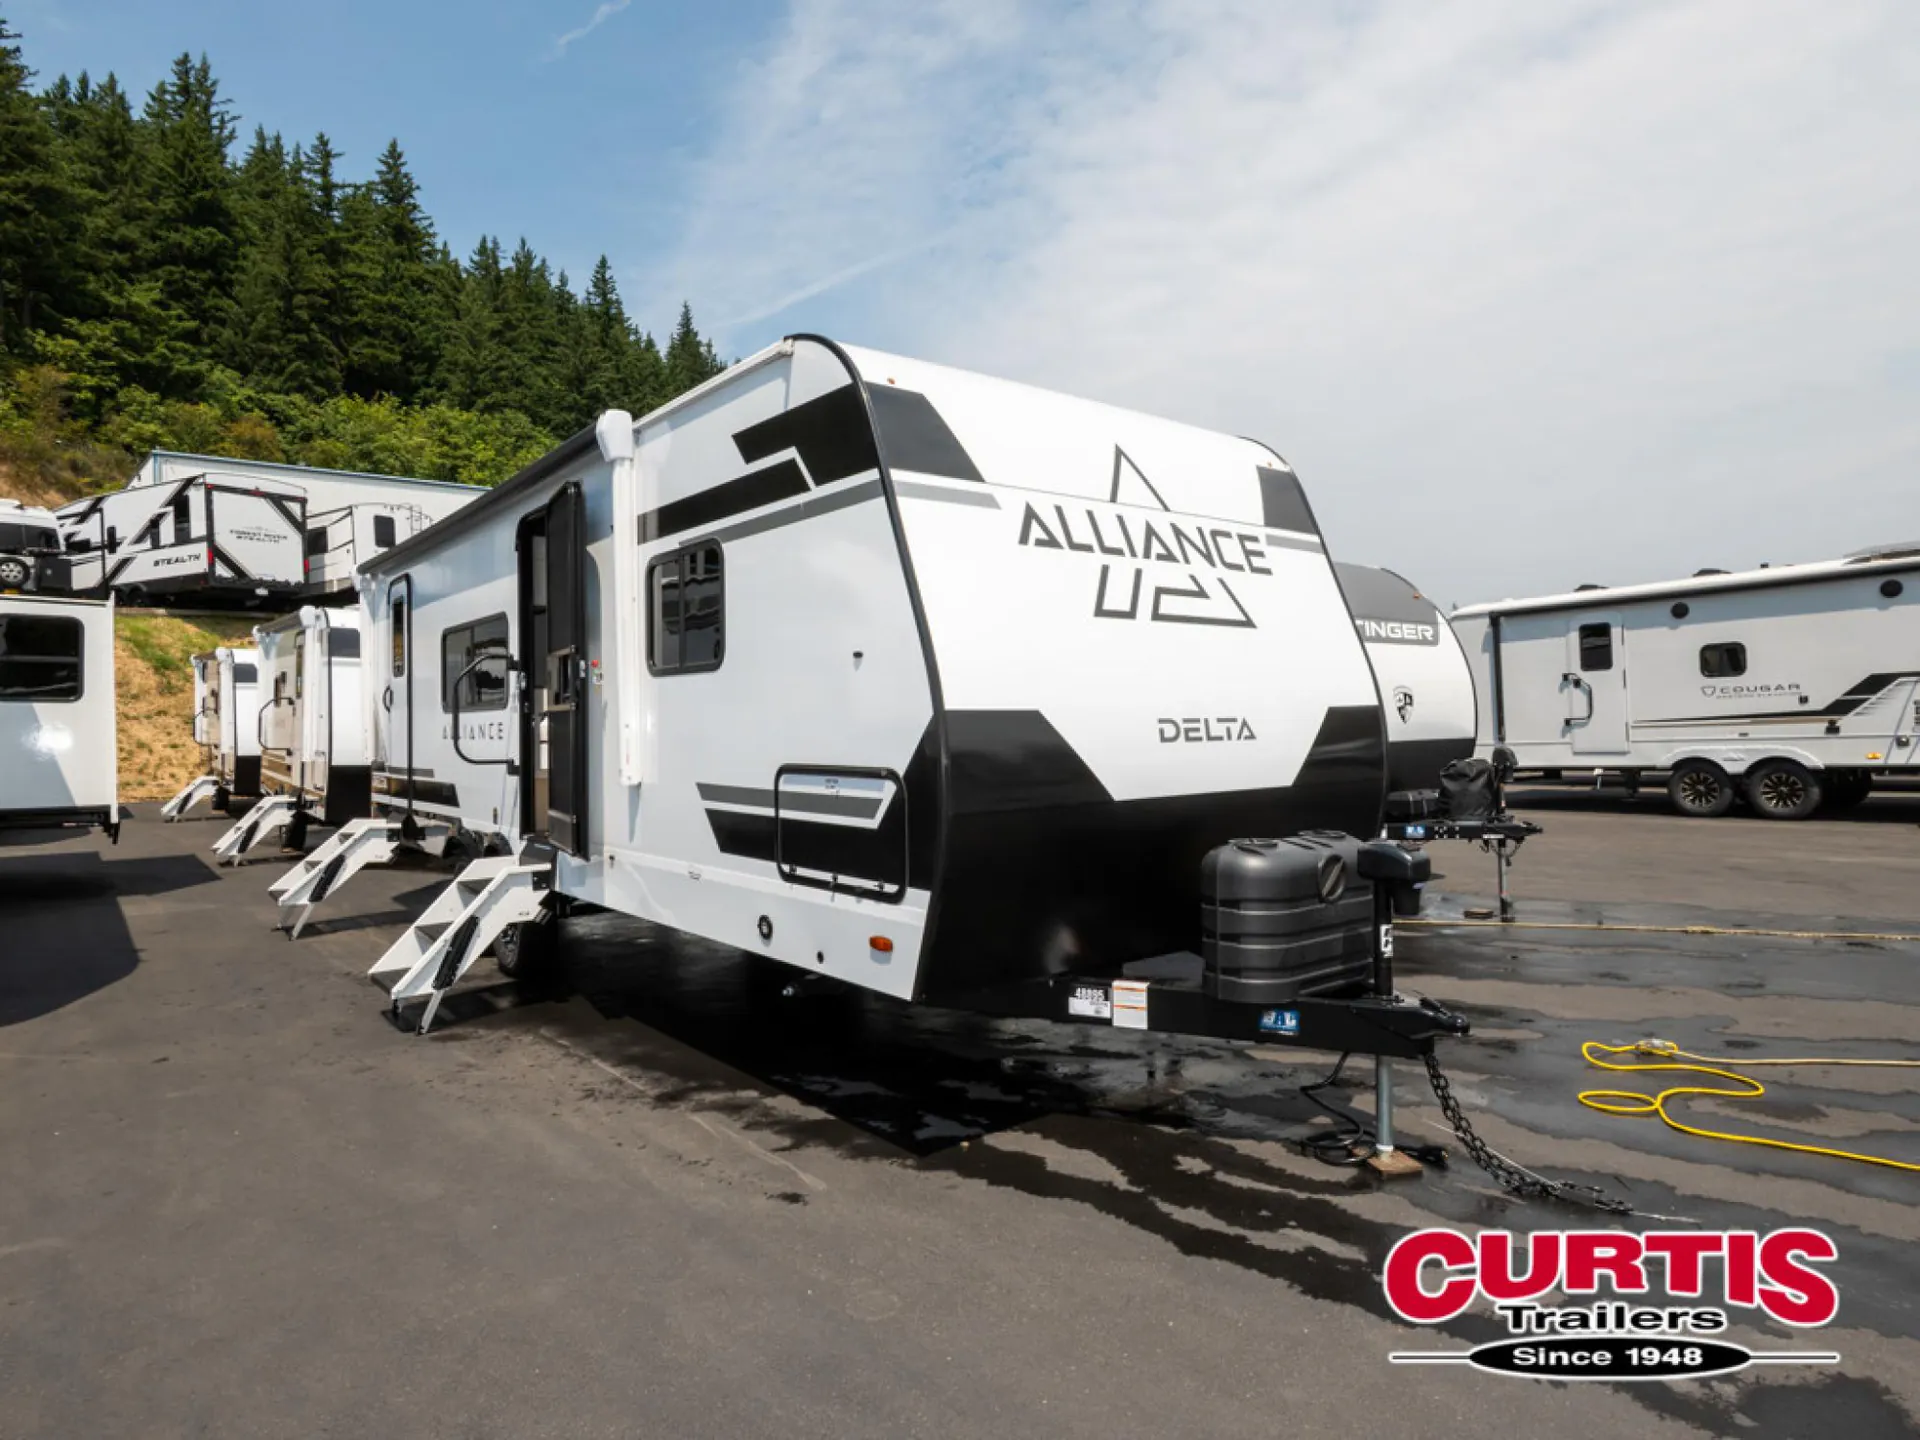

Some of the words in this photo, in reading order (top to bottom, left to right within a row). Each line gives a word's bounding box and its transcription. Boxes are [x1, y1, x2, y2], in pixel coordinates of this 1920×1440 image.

[1018, 499, 1274, 576] ALLIANCE
[153, 552, 202, 567] STEALTH
[1720, 683, 1801, 694] COUGAR
[1158, 717, 1257, 743] DELTA
